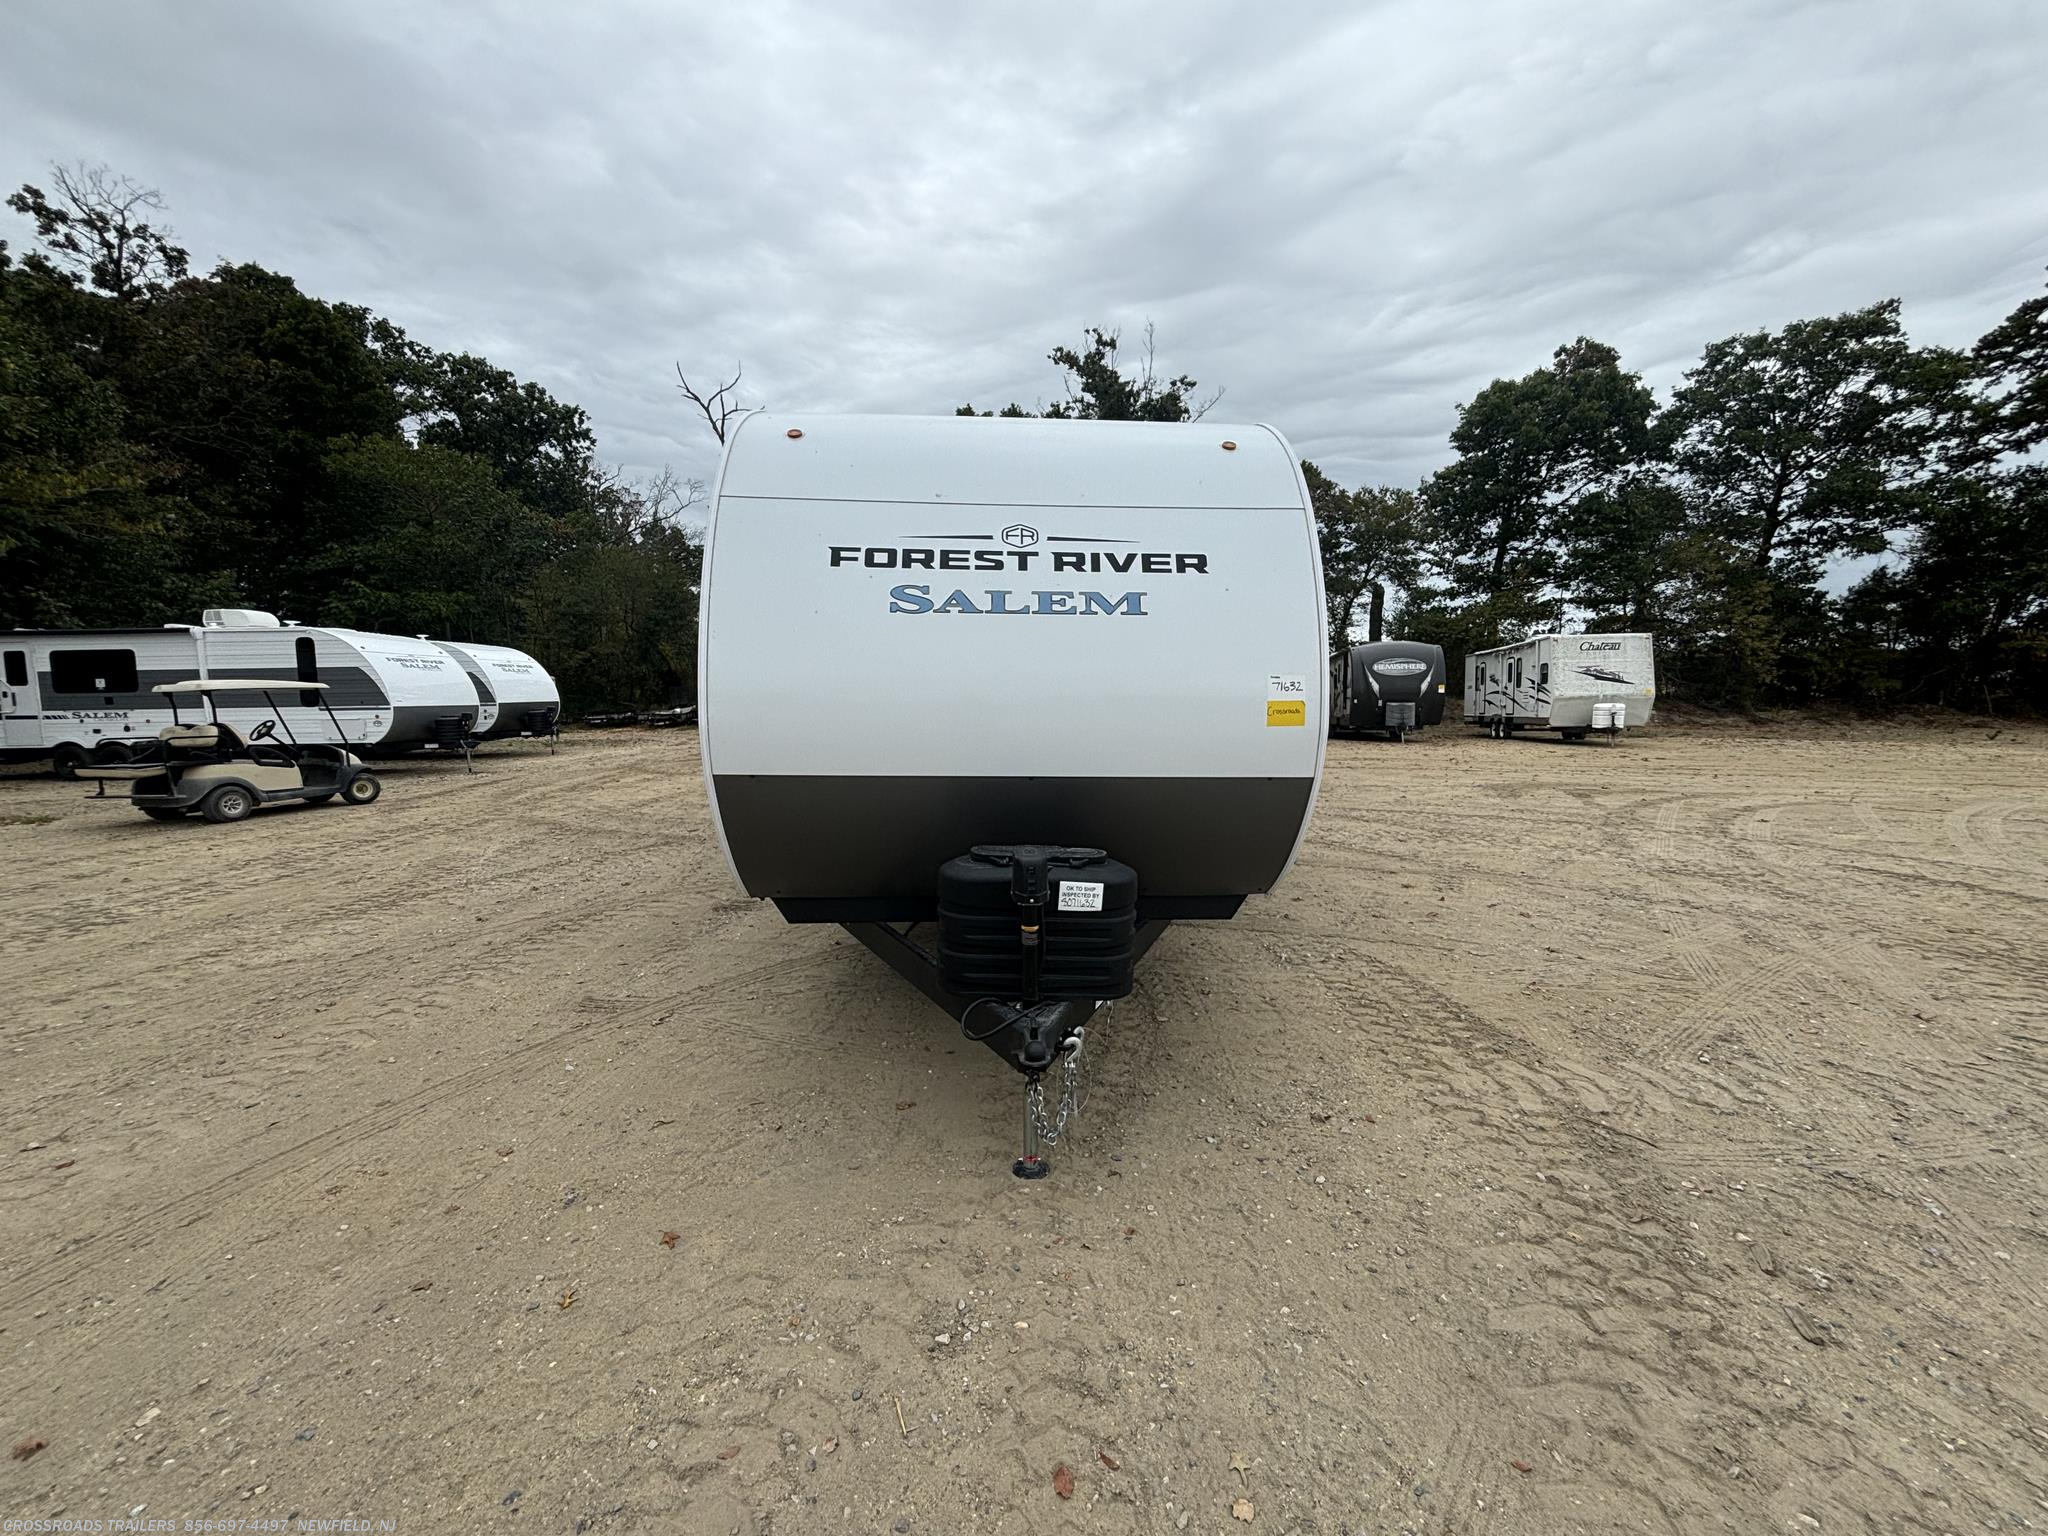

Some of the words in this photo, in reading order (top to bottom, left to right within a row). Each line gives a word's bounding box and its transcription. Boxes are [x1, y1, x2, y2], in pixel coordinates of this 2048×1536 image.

[1005, 527, 1035, 545] FR
[828, 546, 1039, 571] FOREST
[1051, 551, 1209, 574] RIVER
[889, 584, 1148, 616] SALEM
[1580, 641, 1621, 651] Chateau
[1271, 681, 1304, 692] 71632
